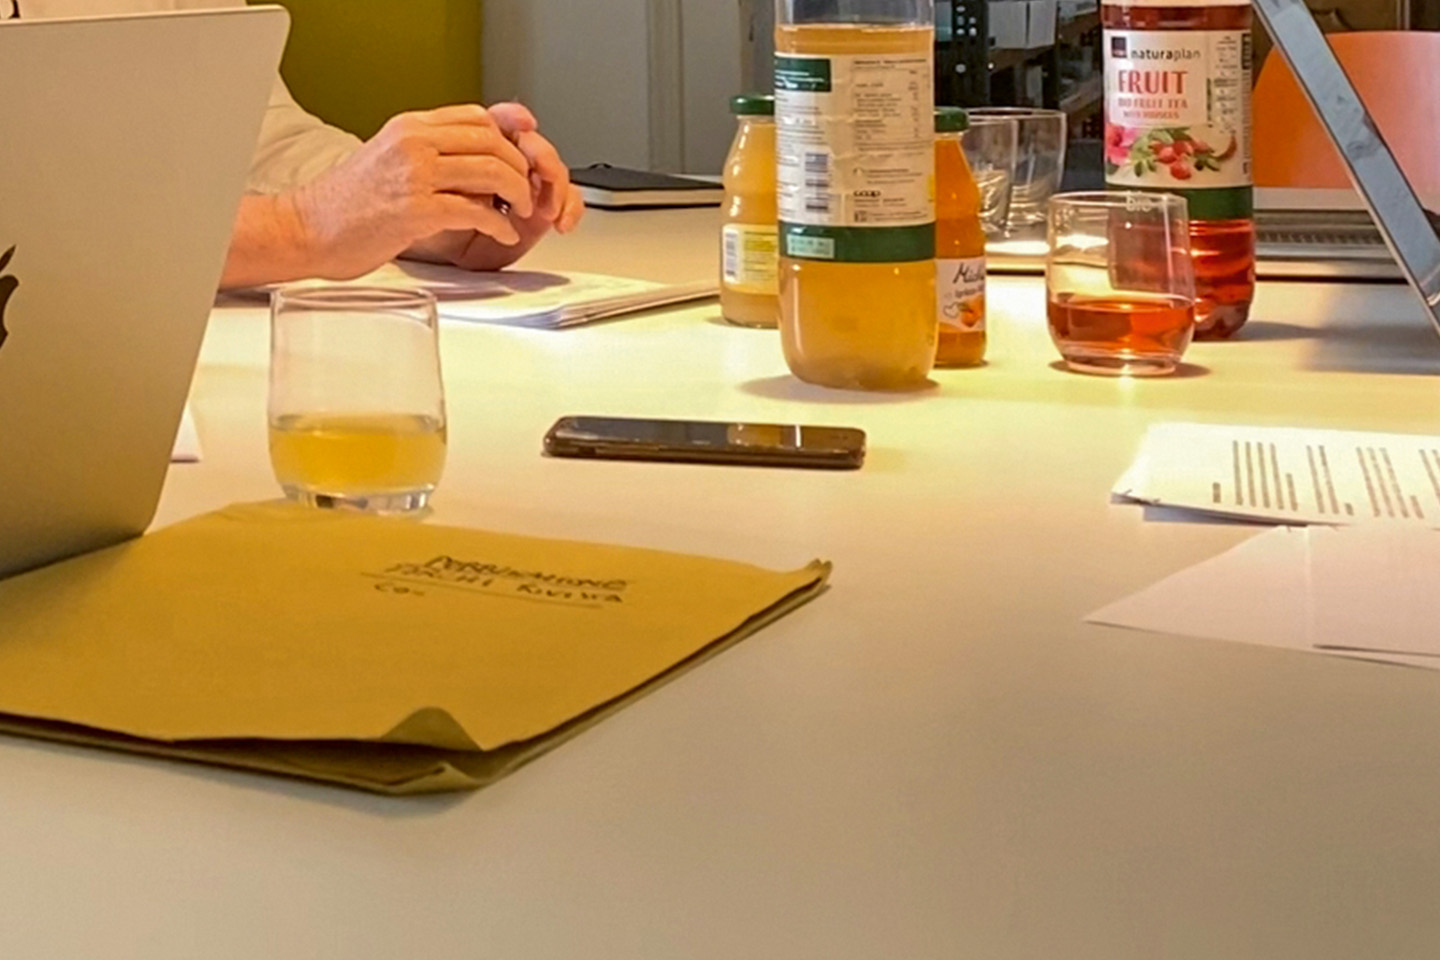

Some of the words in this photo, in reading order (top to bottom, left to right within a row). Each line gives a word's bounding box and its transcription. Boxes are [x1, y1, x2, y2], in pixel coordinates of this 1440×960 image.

[1131, 48, 1201, 62] naturaplan
[1118, 70, 1188, 94] FRUIT
[1134, 98, 1162, 109] FRUIT
[1168, 99, 1188, 109] TEA
